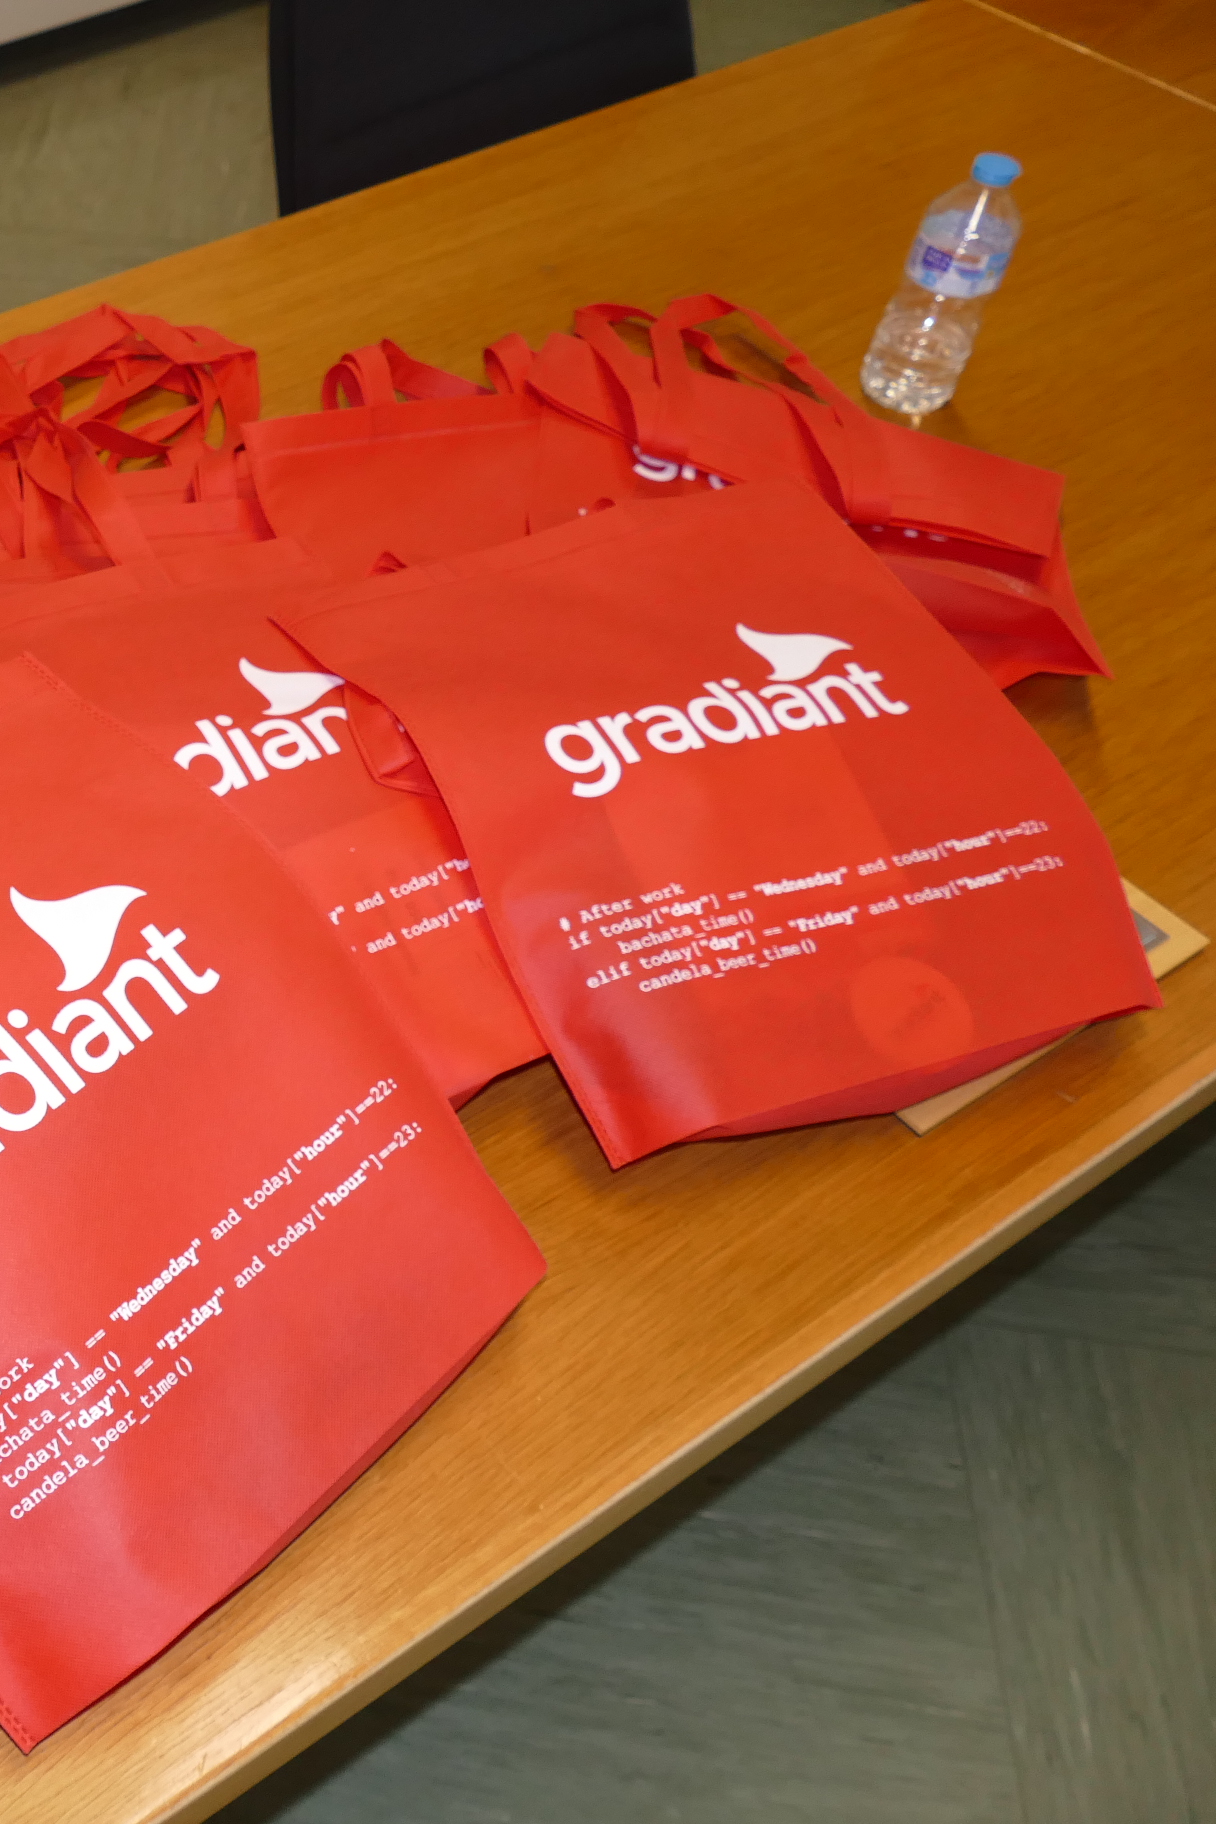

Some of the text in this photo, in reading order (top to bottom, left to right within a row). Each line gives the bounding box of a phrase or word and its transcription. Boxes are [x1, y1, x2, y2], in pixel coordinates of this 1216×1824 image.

[174, 706, 348, 797] dian
[544, 662, 909, 798] gradiant
[354, 891, 385, 913] and
[366, 932, 397, 953] and
[568, 930, 592, 950] if
[857, 857, 888, 876] and
[579, 899, 633, 923] After
[640, 882, 685, 904] work
[586, 961, 632, 989] elif
[868, 895, 900, 915] and
[616, 908, 755, 954] bachata_time()
[639, 938, 817, 993] candela_beer_time()
[85, 1328, 106, 1349] ==
[109, 1237, 201, 1322] "Wednesday"
[210, 1208, 242, 1240] and
[243, 1078, 397, 1210] today["hour"]==22:
[2, 1378, 130, 1488] today["day"]
[134, 1356, 154, 1378] ==
[156, 1286, 225, 1350] "Friday"
[234, 1255, 266, 1288] and
[267, 1121, 422, 1257] today["hour"]==23:
[10, 1355, 193, 1520] candela_beer_time()
